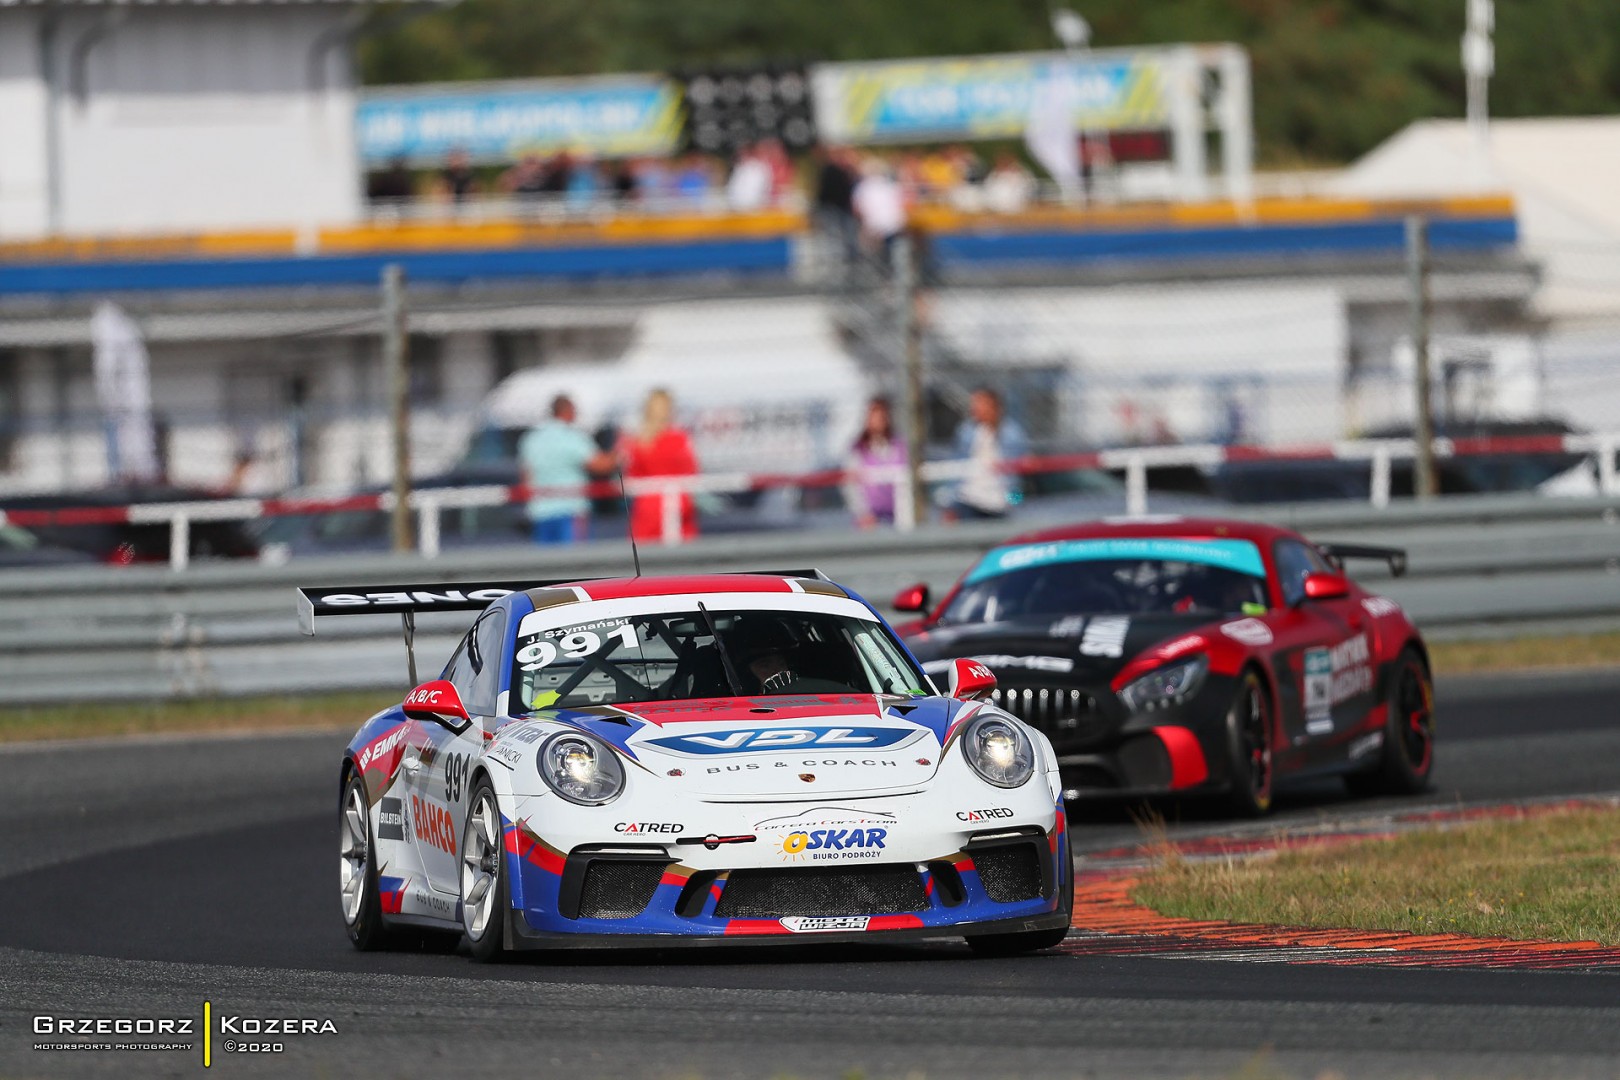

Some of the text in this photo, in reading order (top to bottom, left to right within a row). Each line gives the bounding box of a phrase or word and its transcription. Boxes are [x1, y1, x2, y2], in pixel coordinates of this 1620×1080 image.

[526, 617, 630, 645] J. Szymański
[516, 624, 639, 672] 991
[406, 690, 443, 704] A/B/C
[371, 727, 407, 762] EMKA
[680, 728, 878, 749] VDL
[706, 758, 897, 775] BUS & COACH
[445, 752, 471, 803] 991
[380, 812, 402, 825] BILSTEIN
[956, 807, 1014, 822] CATRED
[412, 794, 457, 857] BAHCO
[613, 822, 684, 834] CATRED
[782, 828, 888, 854] OSKAR
[842, 850, 881, 859] PODRÓŻY
